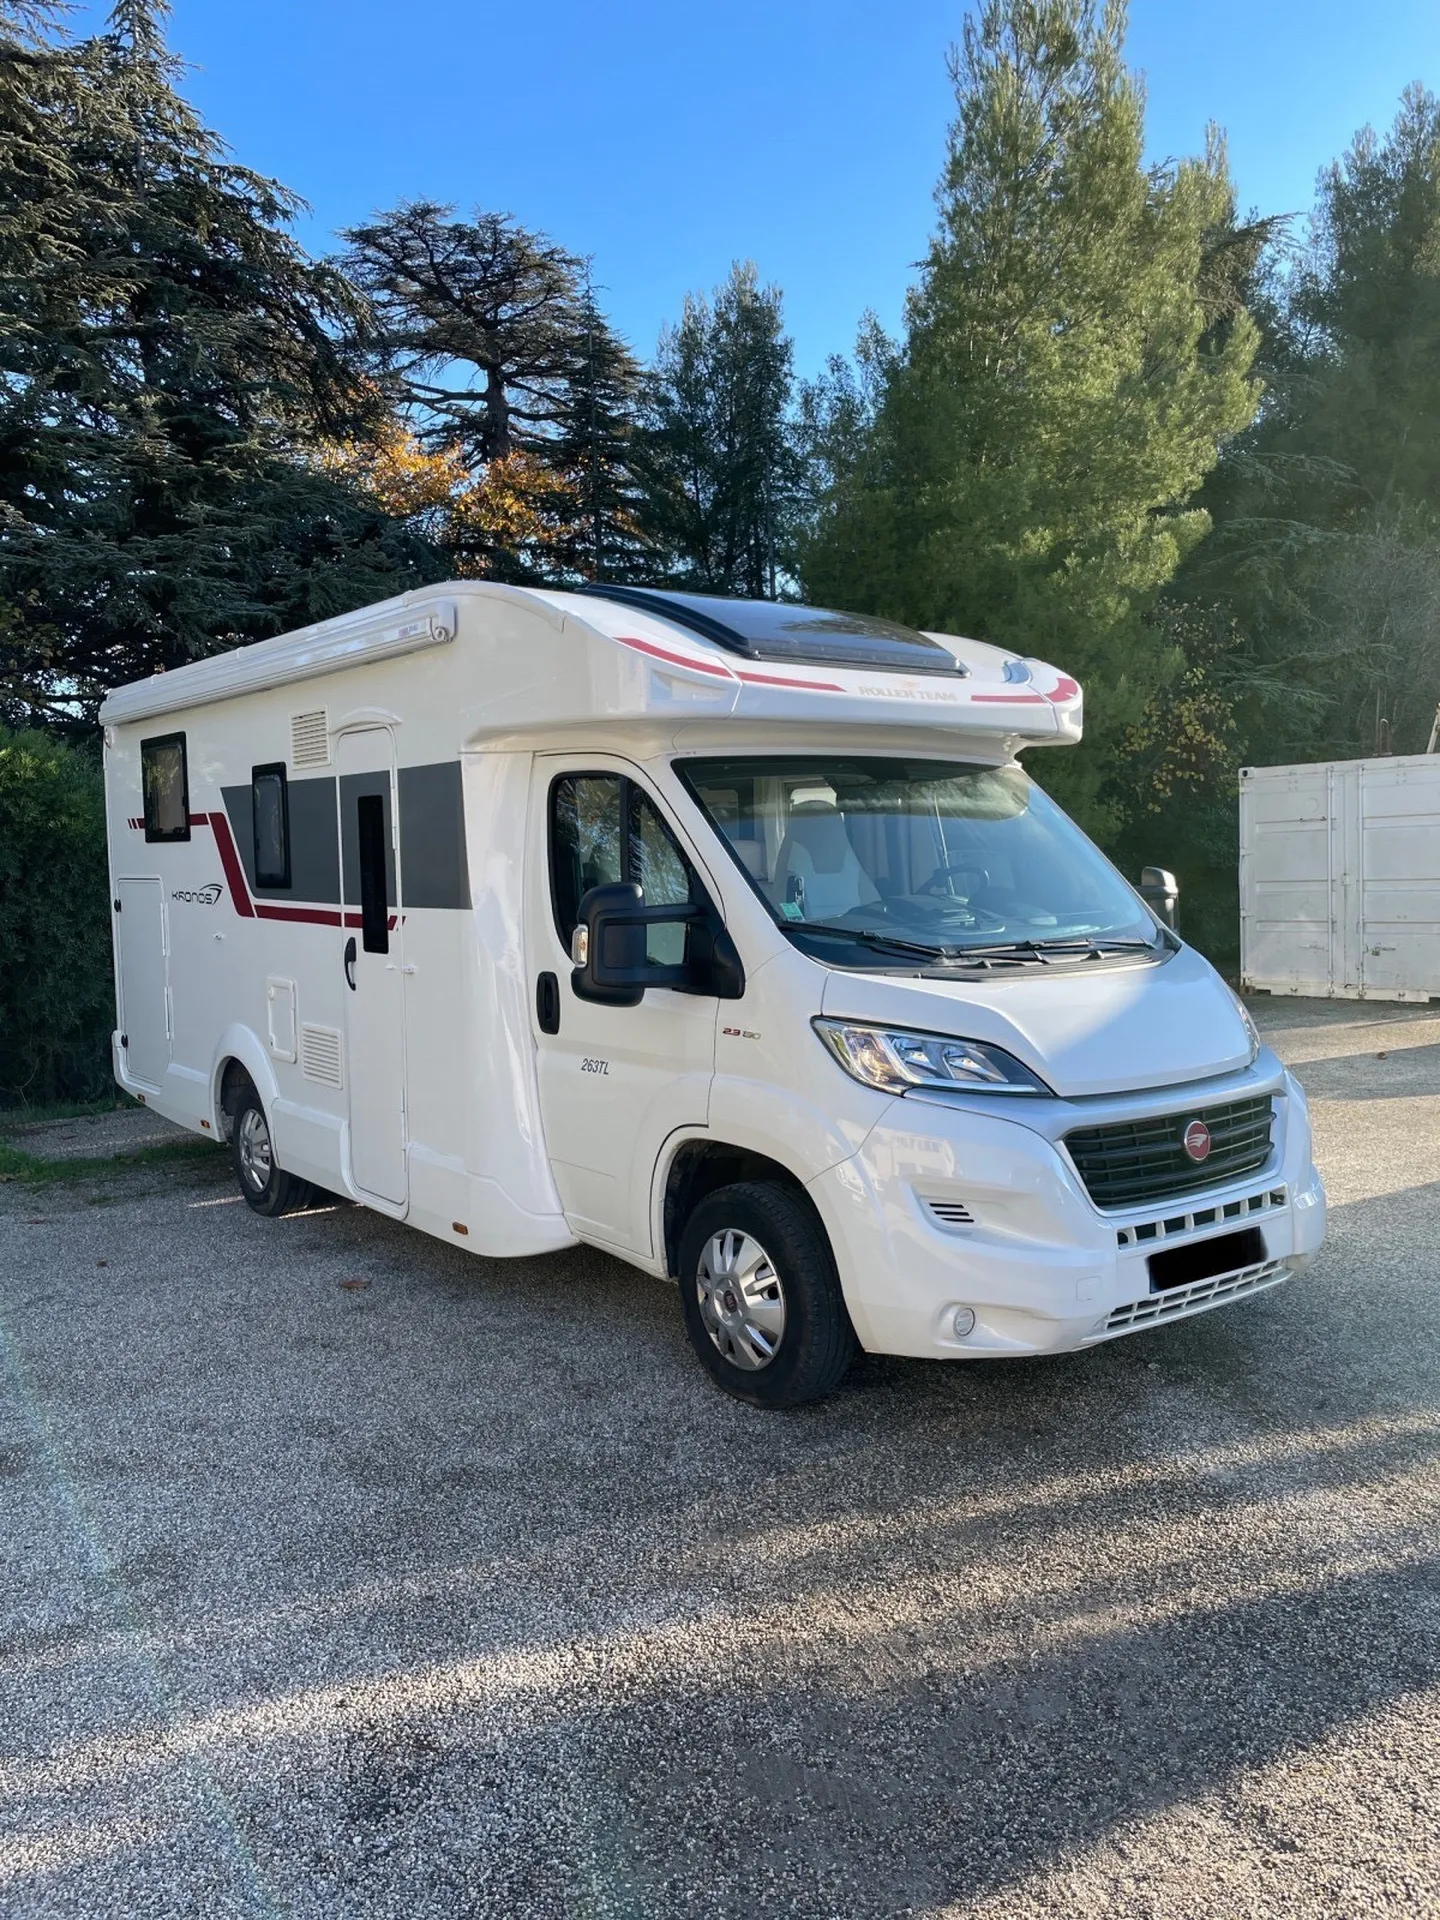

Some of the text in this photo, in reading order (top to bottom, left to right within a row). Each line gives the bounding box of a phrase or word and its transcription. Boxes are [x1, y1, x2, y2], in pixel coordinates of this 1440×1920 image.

[858, 686, 957, 701] ROLLER TEAM
[581, 1058, 609, 1075] 263TL
